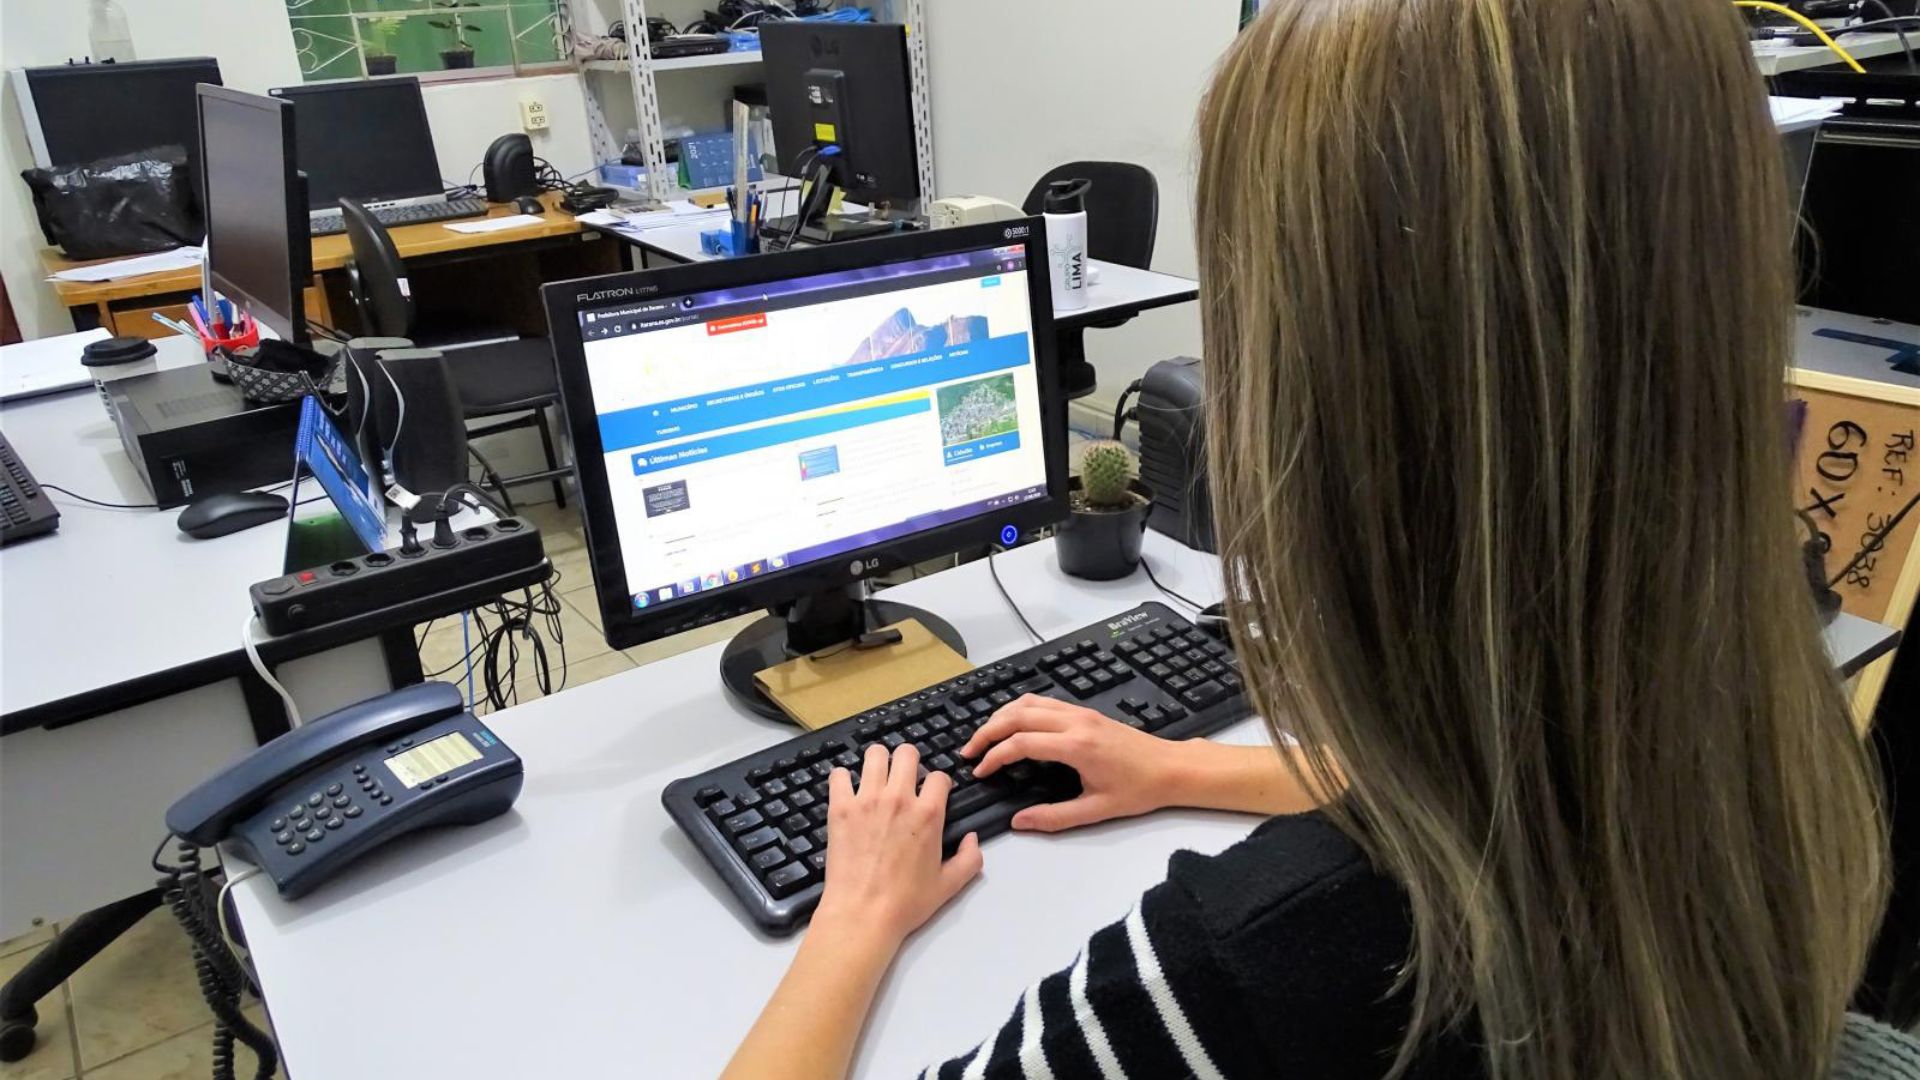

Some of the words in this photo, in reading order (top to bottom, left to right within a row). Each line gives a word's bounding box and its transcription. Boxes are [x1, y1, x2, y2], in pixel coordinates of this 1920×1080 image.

[1072, 252, 1082, 290] LIMA
[576, 286, 634, 302] FLATRON
[597, 309, 619, 318] Prefeitura
[619, 306, 642, 317] Municipal
[649, 453, 678, 465] Últimas
[678, 446, 709, 460] Notícias
[1877, 429, 1914, 497] REF:
